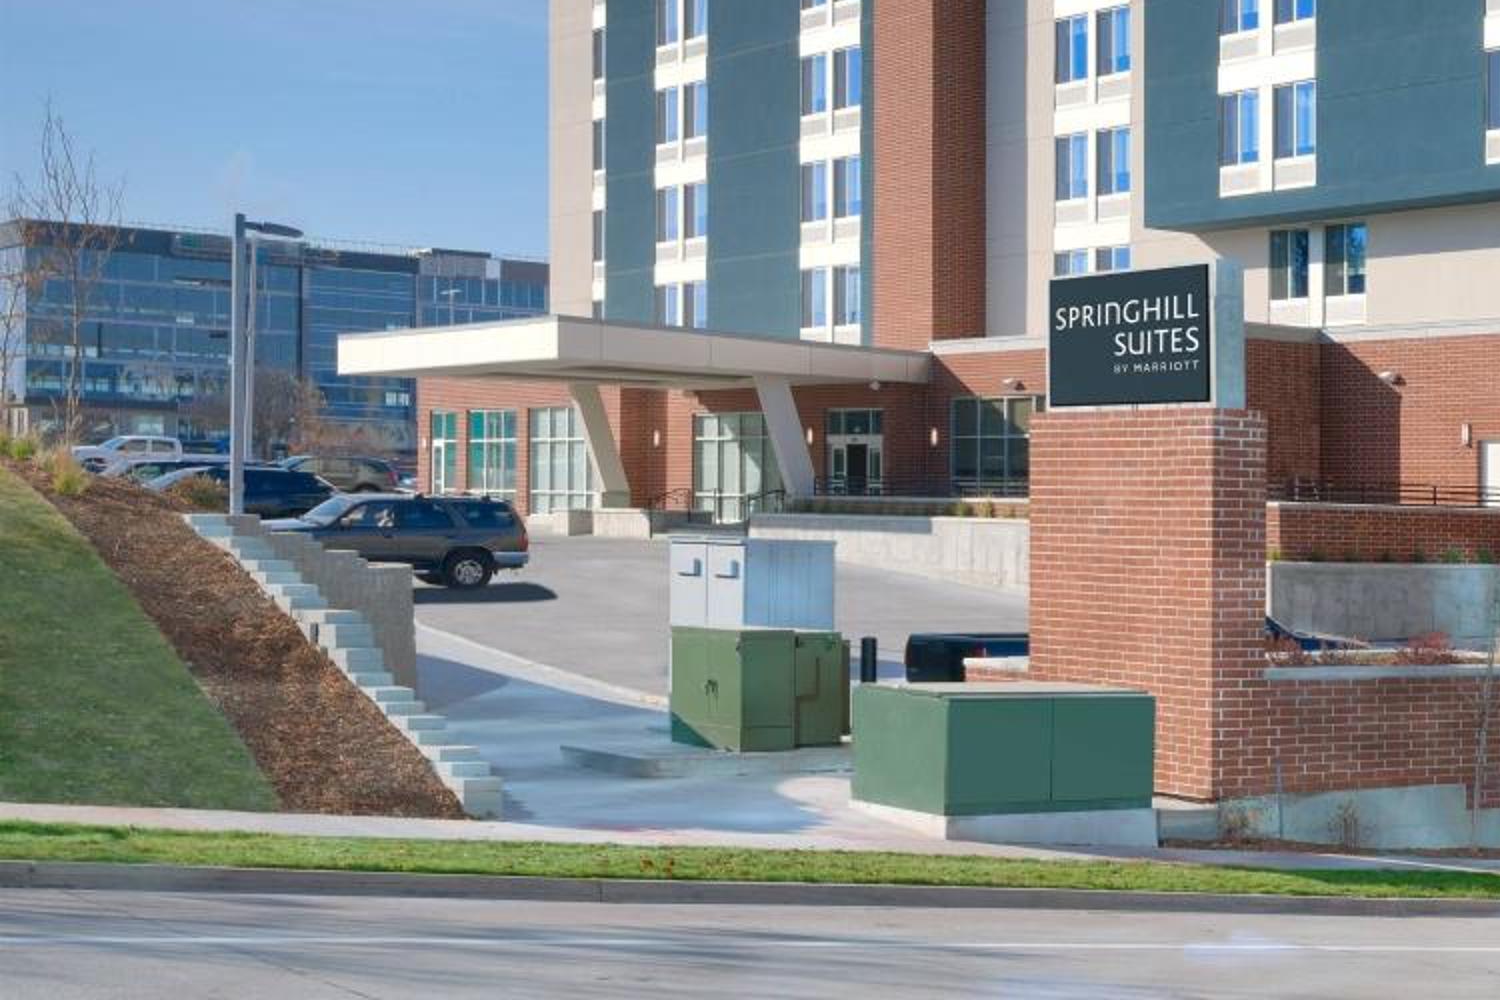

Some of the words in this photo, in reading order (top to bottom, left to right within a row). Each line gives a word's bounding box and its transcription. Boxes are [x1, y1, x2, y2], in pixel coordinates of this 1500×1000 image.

[1055, 293, 1200, 331] SPRINGHILL
[1114, 326, 1200, 357] SUITES
[1113, 363, 1129, 374] BY
[1133, 359, 1200, 373] MARRIOTT
